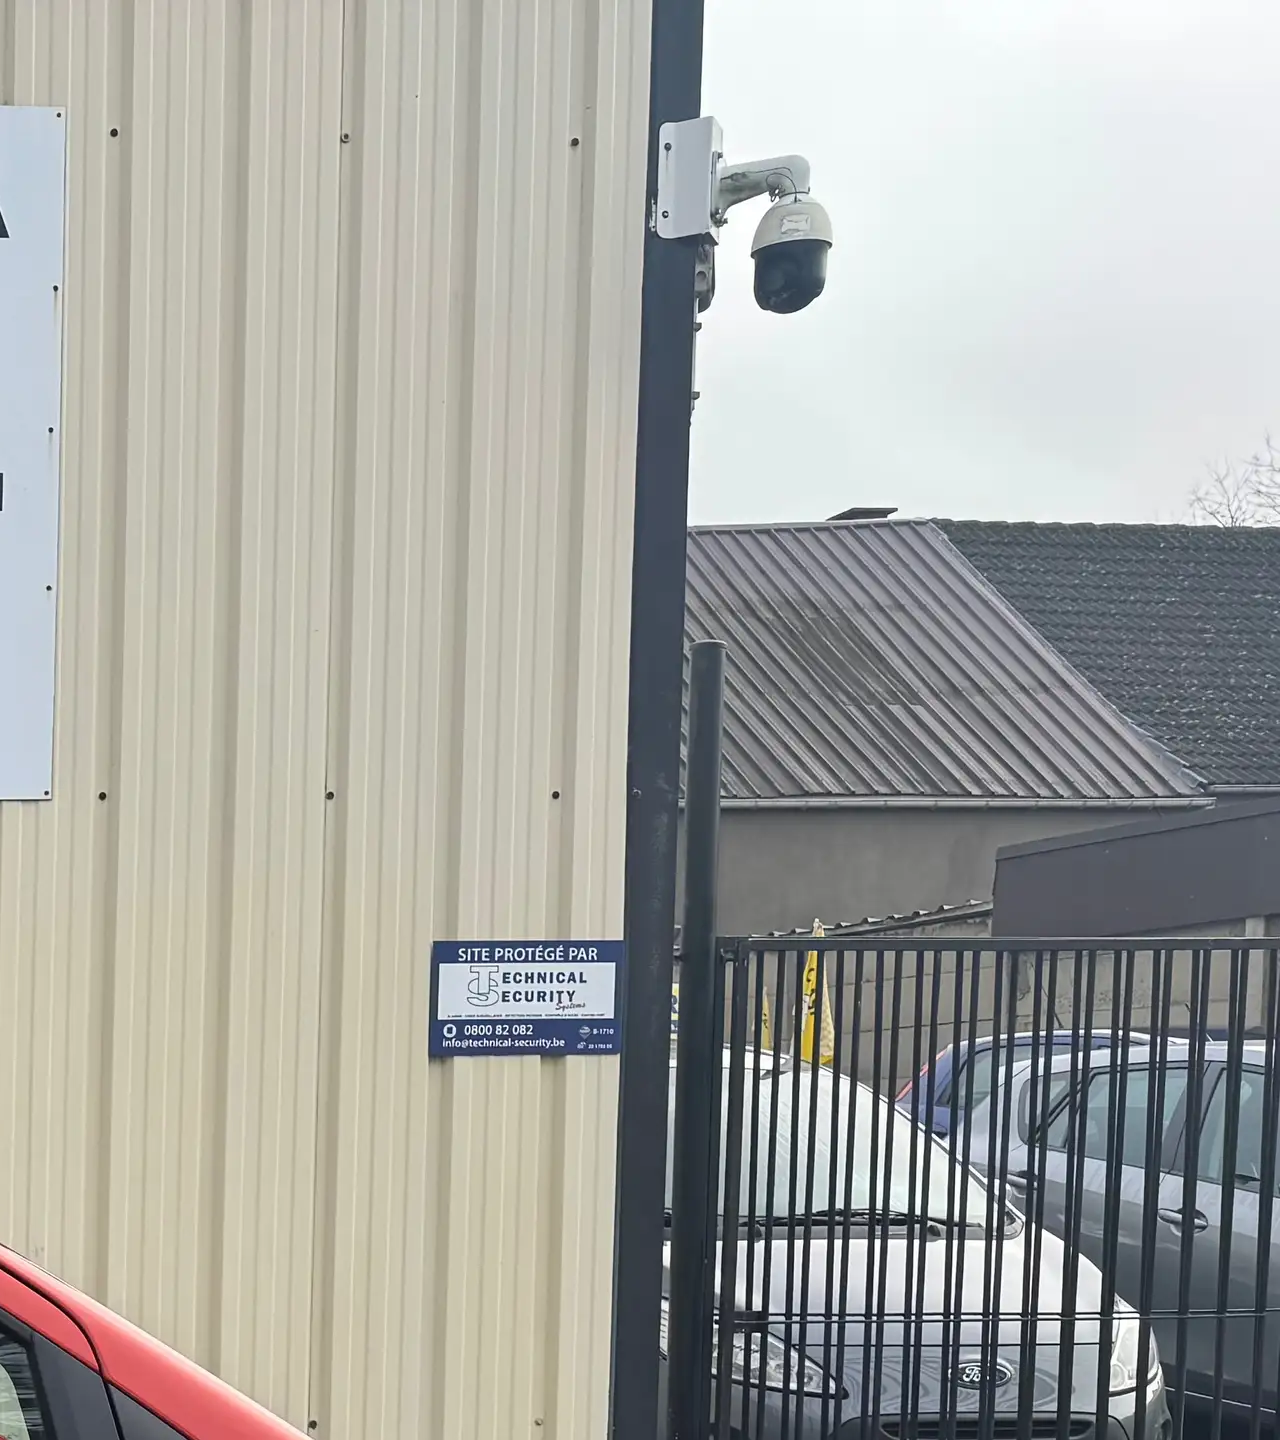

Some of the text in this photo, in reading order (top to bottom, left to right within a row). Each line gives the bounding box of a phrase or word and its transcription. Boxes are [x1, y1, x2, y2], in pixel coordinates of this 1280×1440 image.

[458, 945, 598, 961] SITE PROTÉGÉ PAR
[464, 1024, 534, 1036] 0800 82 082
[442, 1037, 566, 1050] info@technical-security.be
